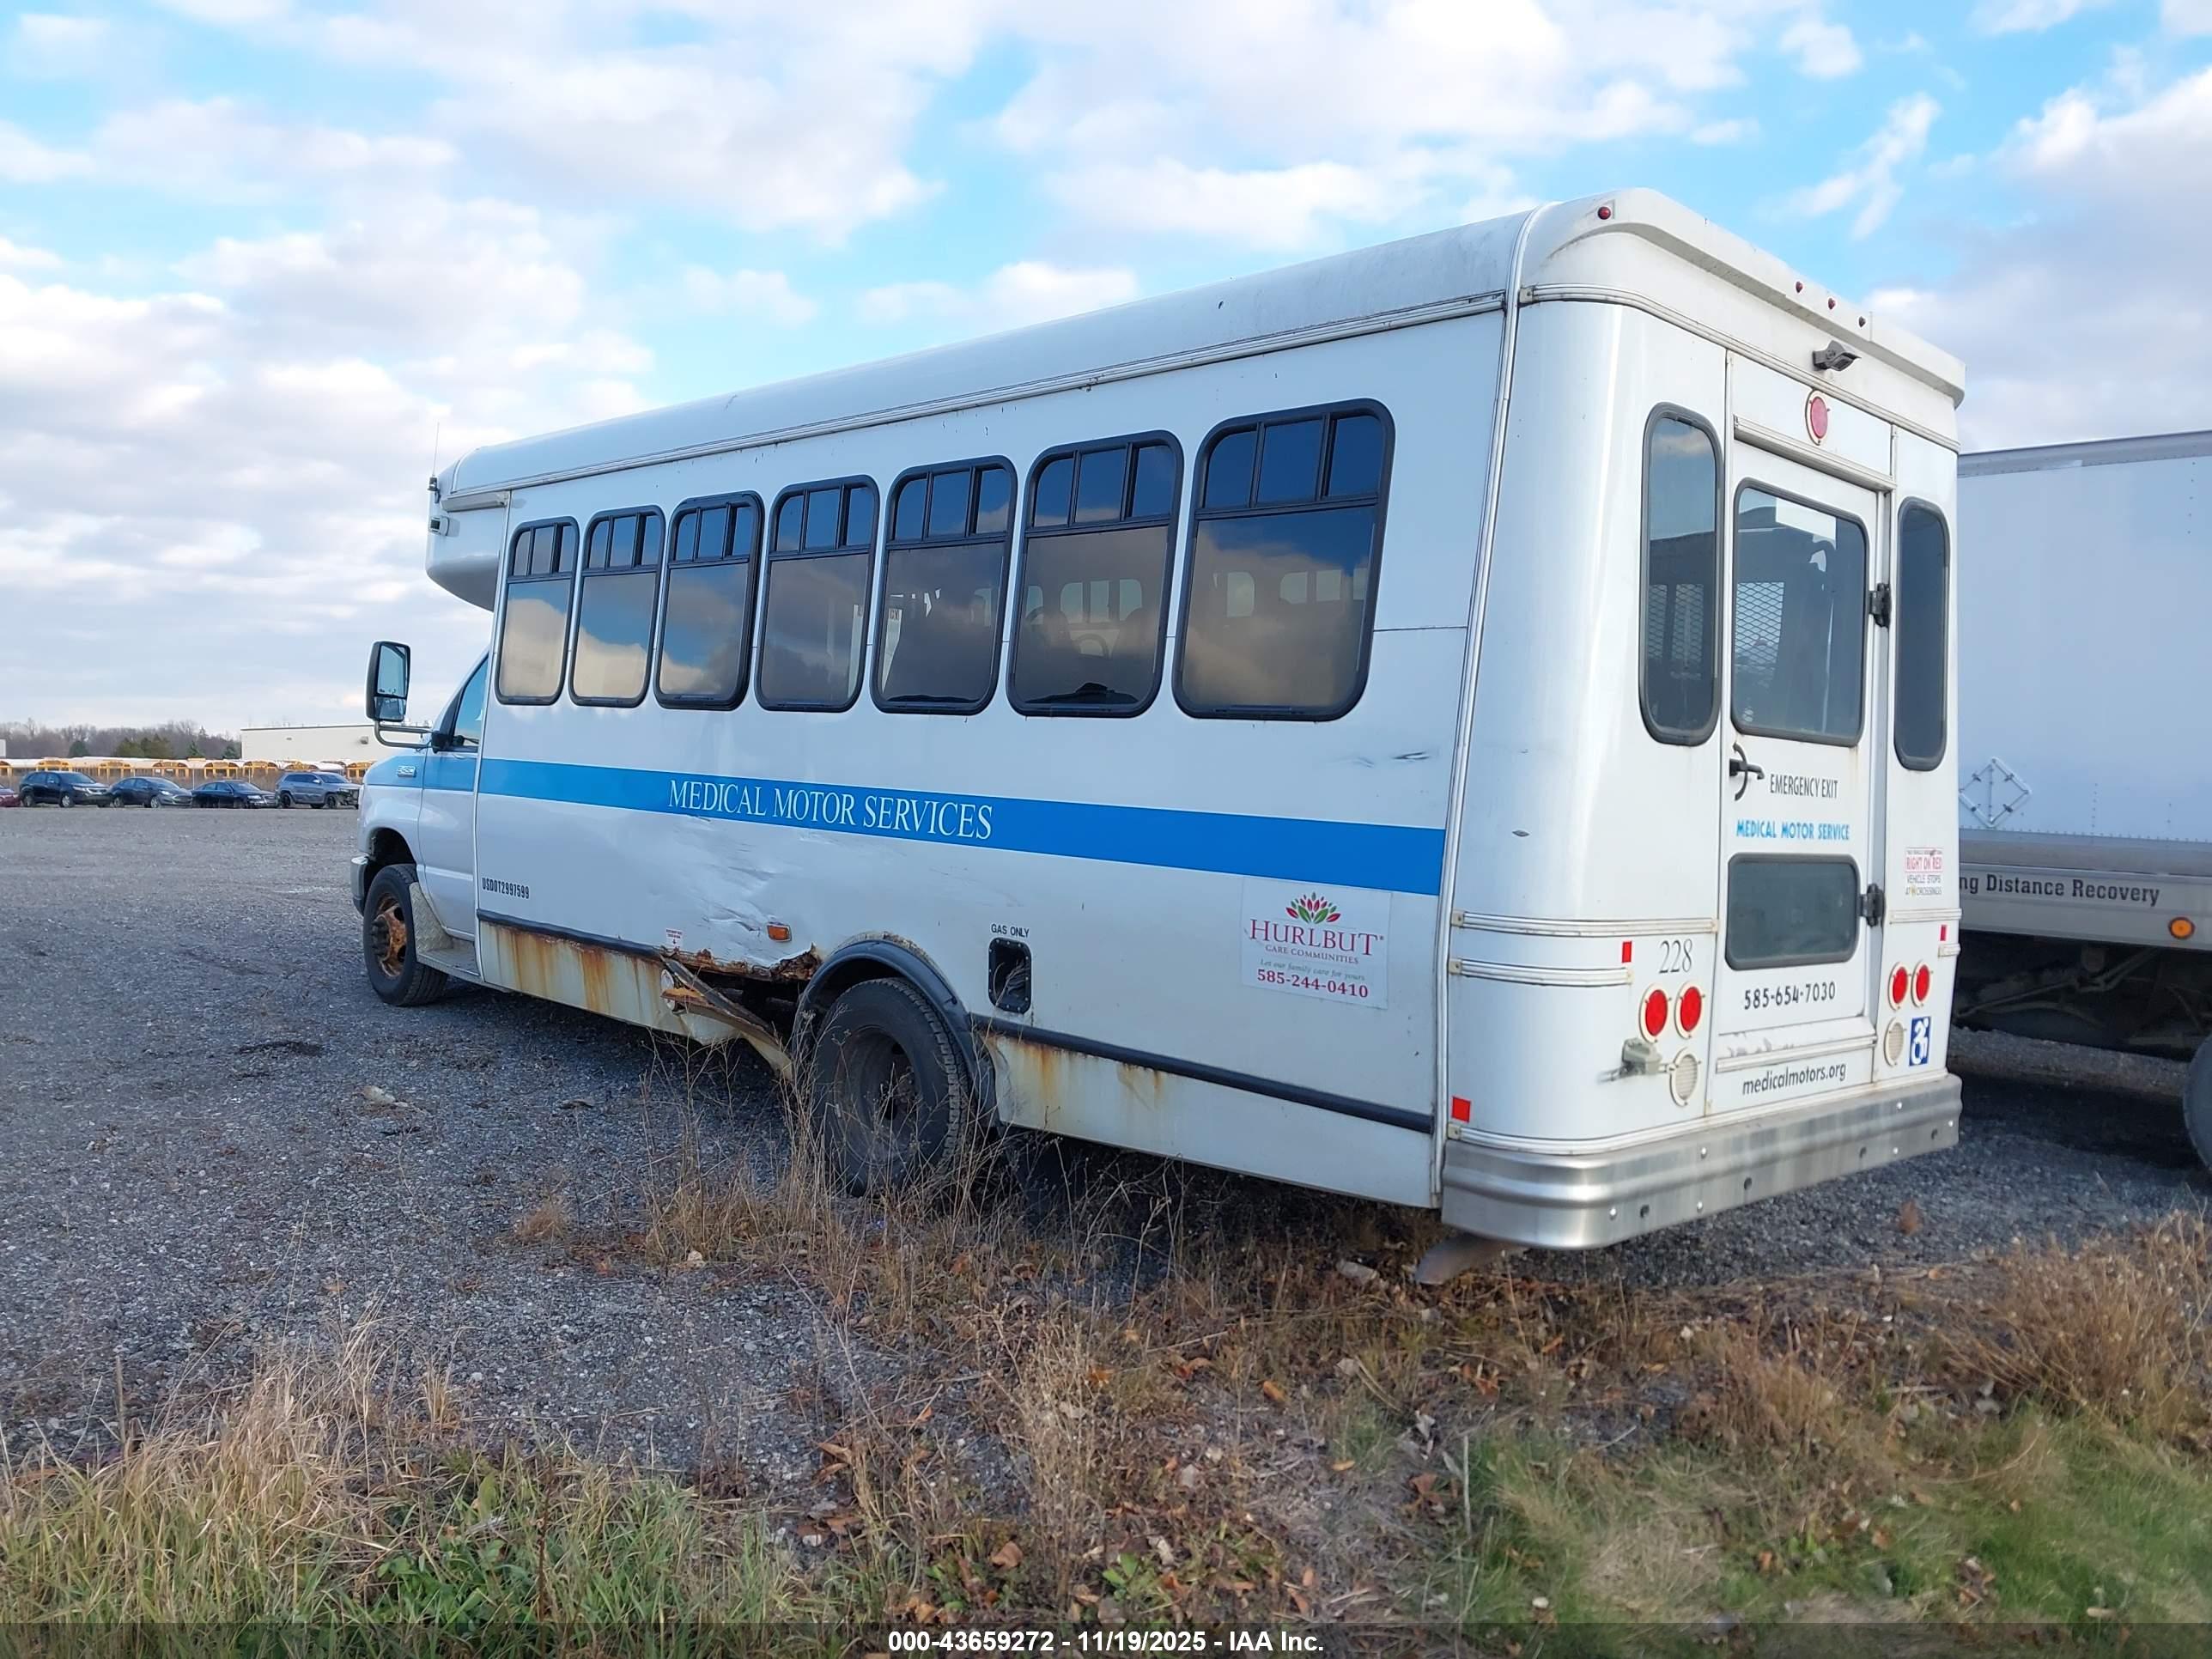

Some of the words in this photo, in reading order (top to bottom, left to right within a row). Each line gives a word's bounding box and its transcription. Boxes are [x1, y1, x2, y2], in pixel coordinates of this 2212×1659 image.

[1770, 774, 1820, 797] EMERGENCY
[1821, 779, 1838, 799] EXIT
[668, 780, 767, 817] MEDICAL
[773, 788, 856, 826] MOTOR
[863, 795, 993, 840] SERVICES
[1736, 819, 1777, 838] MEDICAL
[1781, 822, 1814, 839] MOTOR
[1818, 823, 1850, 841] SERVICE
[1960, 876, 1979, 895] ng
[1986, 874, 2065, 896] Distance
[2072, 879, 2160, 907] Recovery
[991, 923, 1007, 934] GAS
[1010, 927, 1030, 937] ONLY
[1249, 919, 1378, 956] HURLBUT
[1265, 945, 1288, 954] CARE
[1291, 948, 1359, 964] COMMUNITIES
[1658, 939, 1693, 974] 228
[1257, 969, 1368, 998] 585-244-0410
[1744, 981, 1837, 1010] 585-654-7030
[1742, 1063, 1846, 1096] medicalmotors.org
